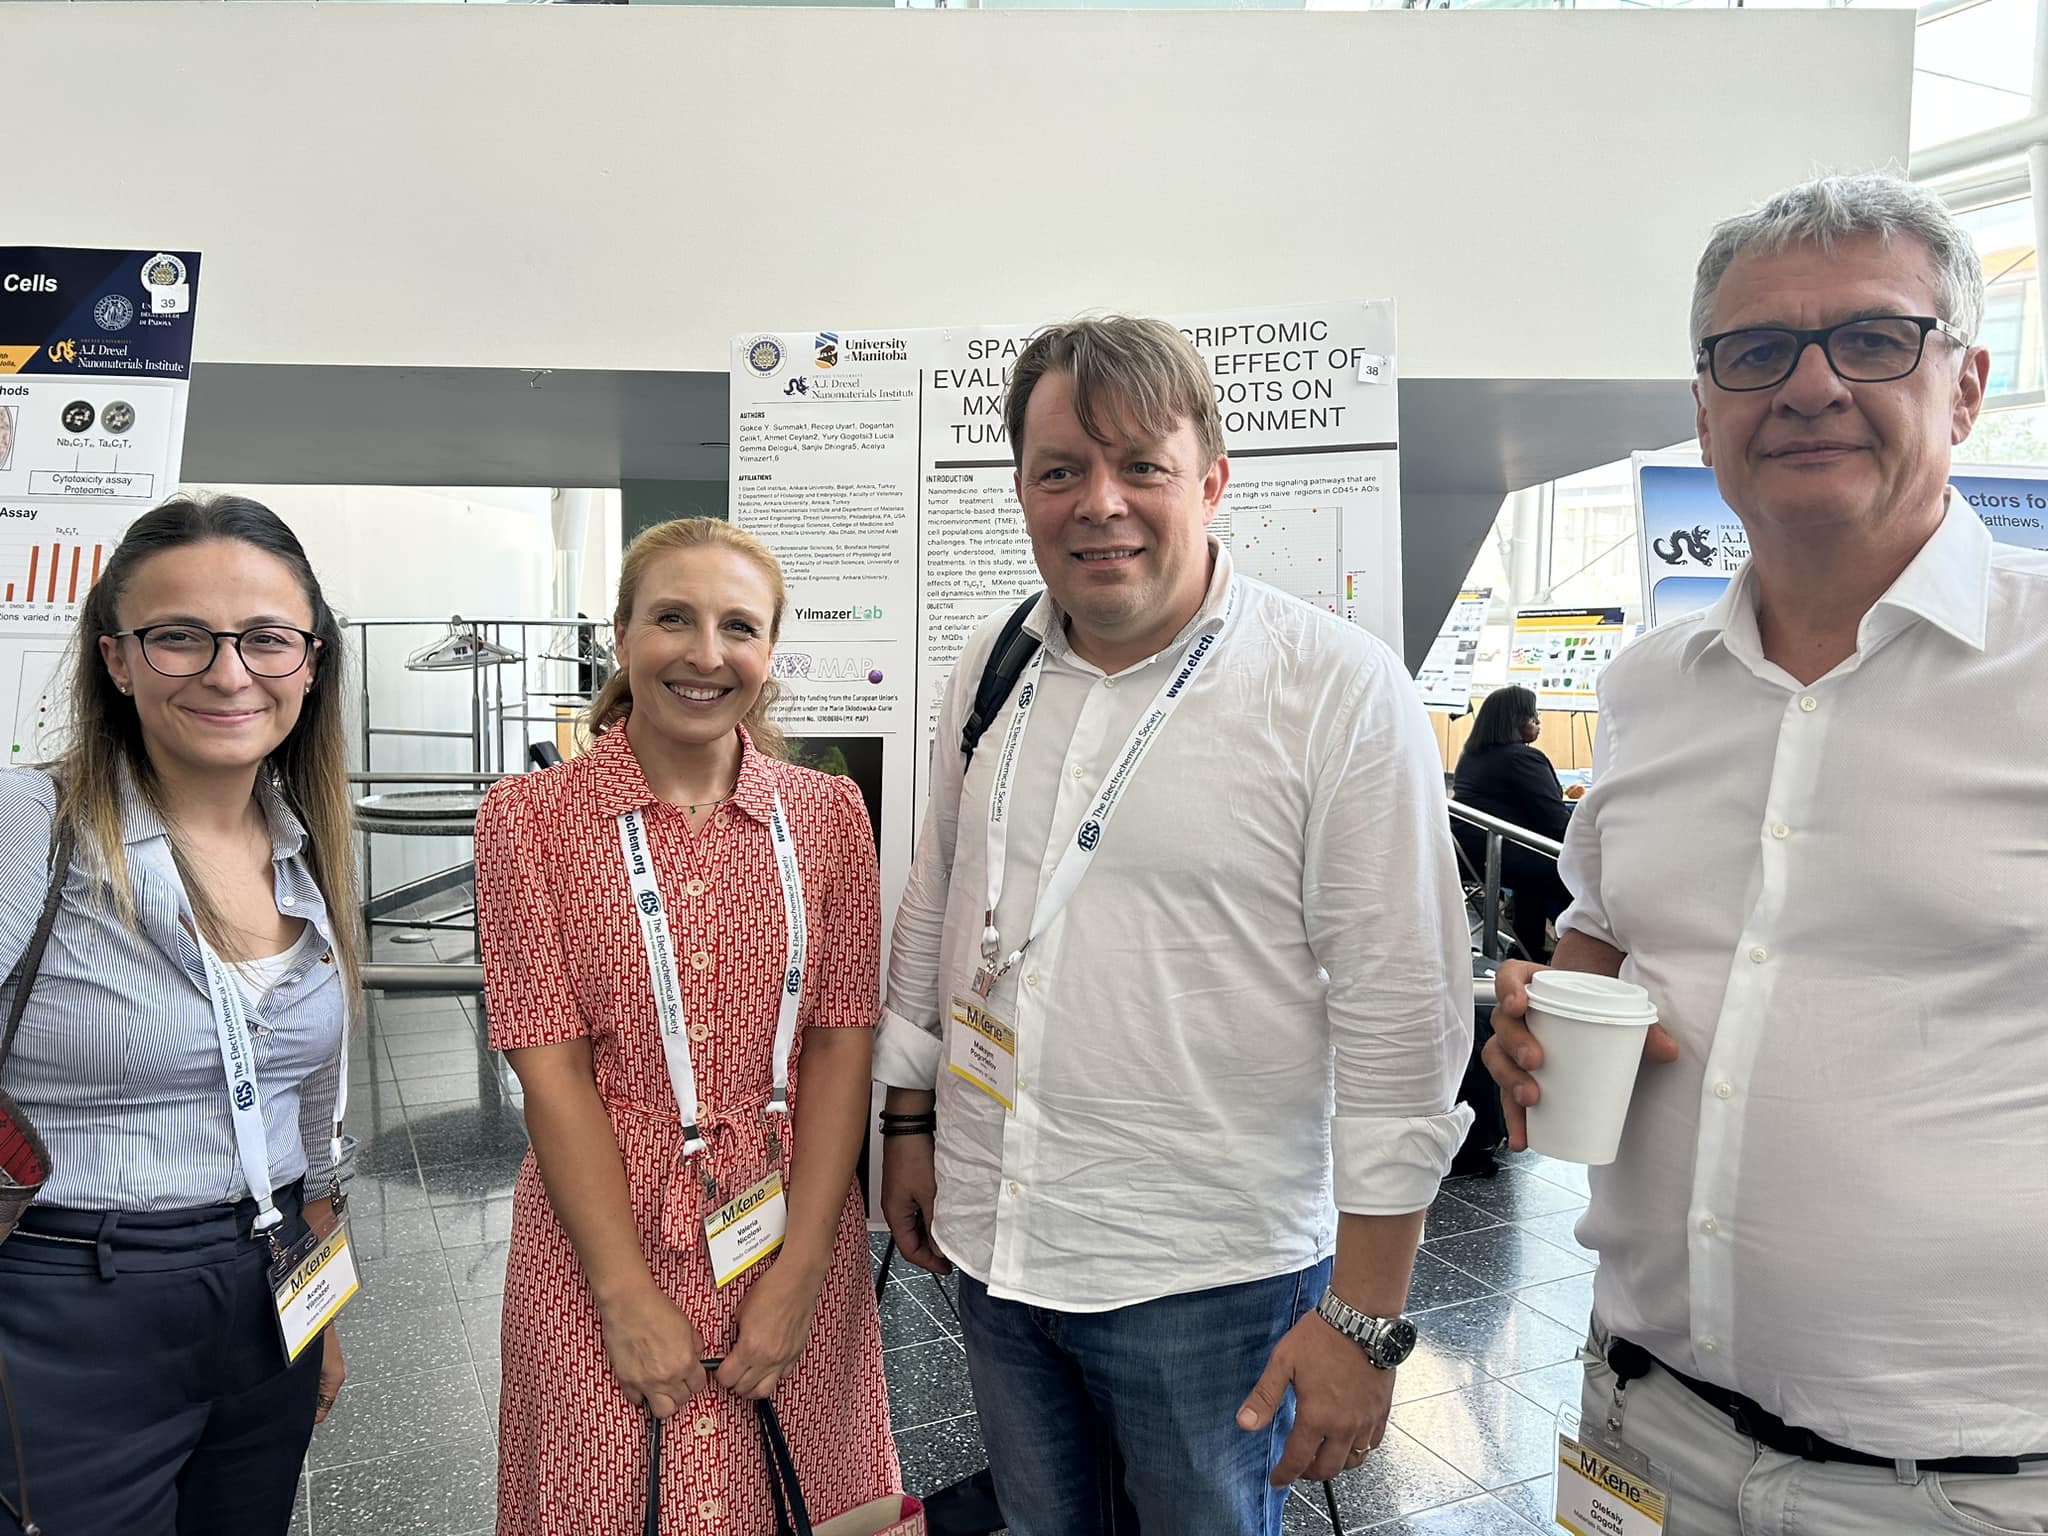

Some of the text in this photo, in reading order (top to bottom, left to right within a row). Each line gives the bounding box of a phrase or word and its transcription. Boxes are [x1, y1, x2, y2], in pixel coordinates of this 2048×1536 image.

[4, 274, 58, 292] Cells
[160, 299, 176, 308] 39
[79, 345, 128, 356] A.J. Drexel
[845, 338, 907, 351] University
[851, 351, 907, 362] Manitoba
[1215, 348, 1366, 374] EFFECT OF
[78, 359, 184, 372] Nanomaterials Institute
[1366, 365, 1379, 376] 38
[0, 386, 29, 396] hods
[812, 379, 860, 389] A.J. Drexel
[1292, 379, 1332, 400] ON
[812, 390, 877, 399] Nanomaterials
[811, 423, 834, 431] Recep
[859, 422, 894, 430] Dogantan
[1220, 407, 1346, 432] ONMENT
[822, 433, 838, 441] Yury
[951, 424, 1005, 443] TUM
[802, 444, 822, 452] Sanjiv
[52, 474, 132, 486] Cytotoxicity assay
[1275, 479, 1308, 487] signaling
[64, 486, 114, 495] Proteomics
[1294, 488, 1322, 496] regions
[0, 507, 38, 520] Assay
[1721, 532, 1746, 543] A.J.
[65, 614, 78, 622] the
[1016, 711, 1026, 726] The
[999, 726, 1021, 790] Electrochemical
[1091, 800, 1107, 819] The
[1101, 737, 1143, 802] Electrochemical
[1138, 709, 1163, 738] Society
[994, 792, 1007, 823] Society
[781, 855, 792, 883] Society
[787, 884, 800, 947] Electrochemical
[652, 918, 661, 933] The
[791, 949, 800, 964] The
[656, 934, 675, 1002] Electrochemical
[217, 985, 241, 1061] Electrochemical
[668, 1003, 679, 1035] Society
[234, 1061, 243, 1081] The
[736, 1219, 758, 1237] Valeria
[737, 1226, 762, 1246] Nicolosi
